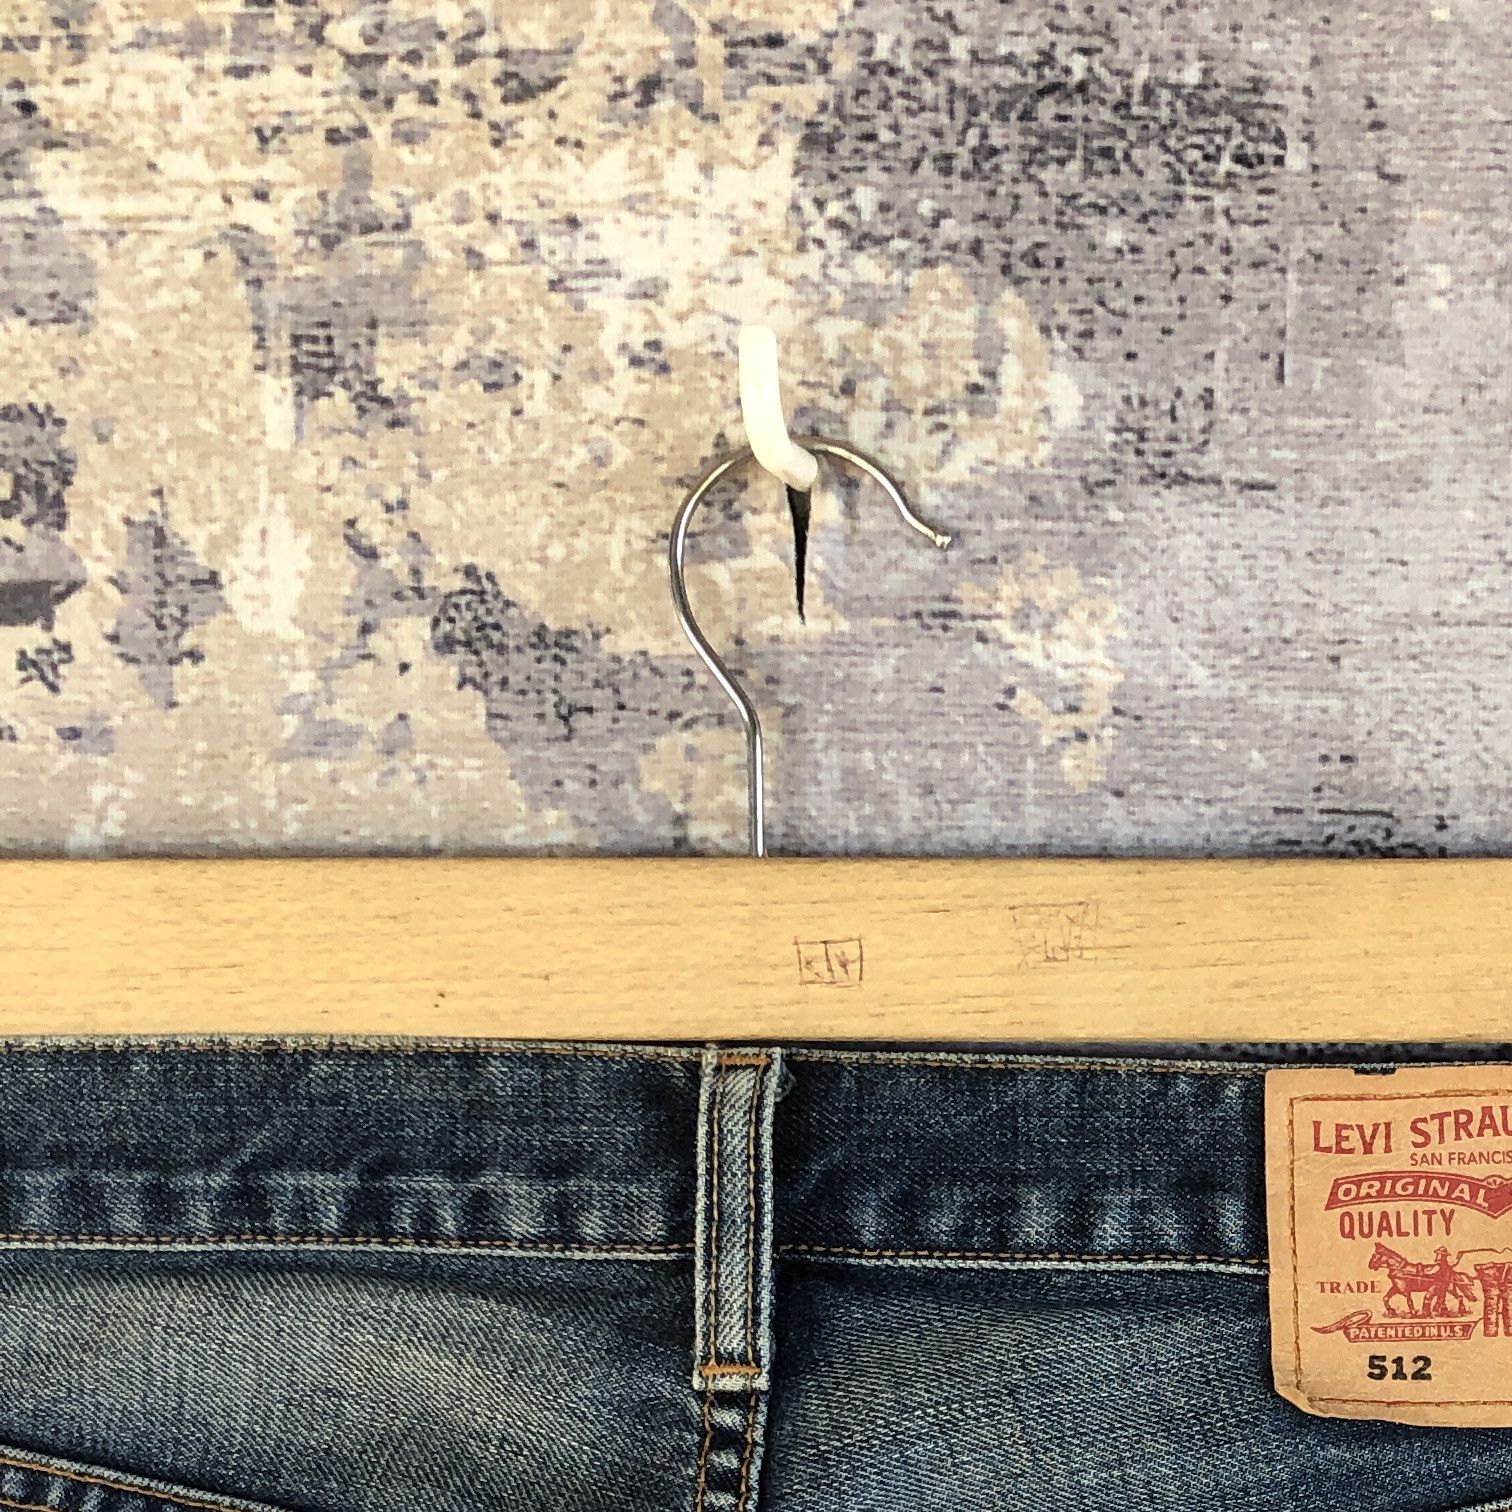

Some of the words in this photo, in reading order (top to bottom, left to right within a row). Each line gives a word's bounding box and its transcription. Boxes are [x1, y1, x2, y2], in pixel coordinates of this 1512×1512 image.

[1312, 1120, 1393, 1155] LEVI
[1410, 1152, 1442, 1166] SAN
[1336, 1177, 1491, 1208] ORIGINAL
[1339, 1209, 1456, 1240] QUALITY
[1316, 1279, 1381, 1295] TRADE
[1367, 1354, 1432, 1381] 512
